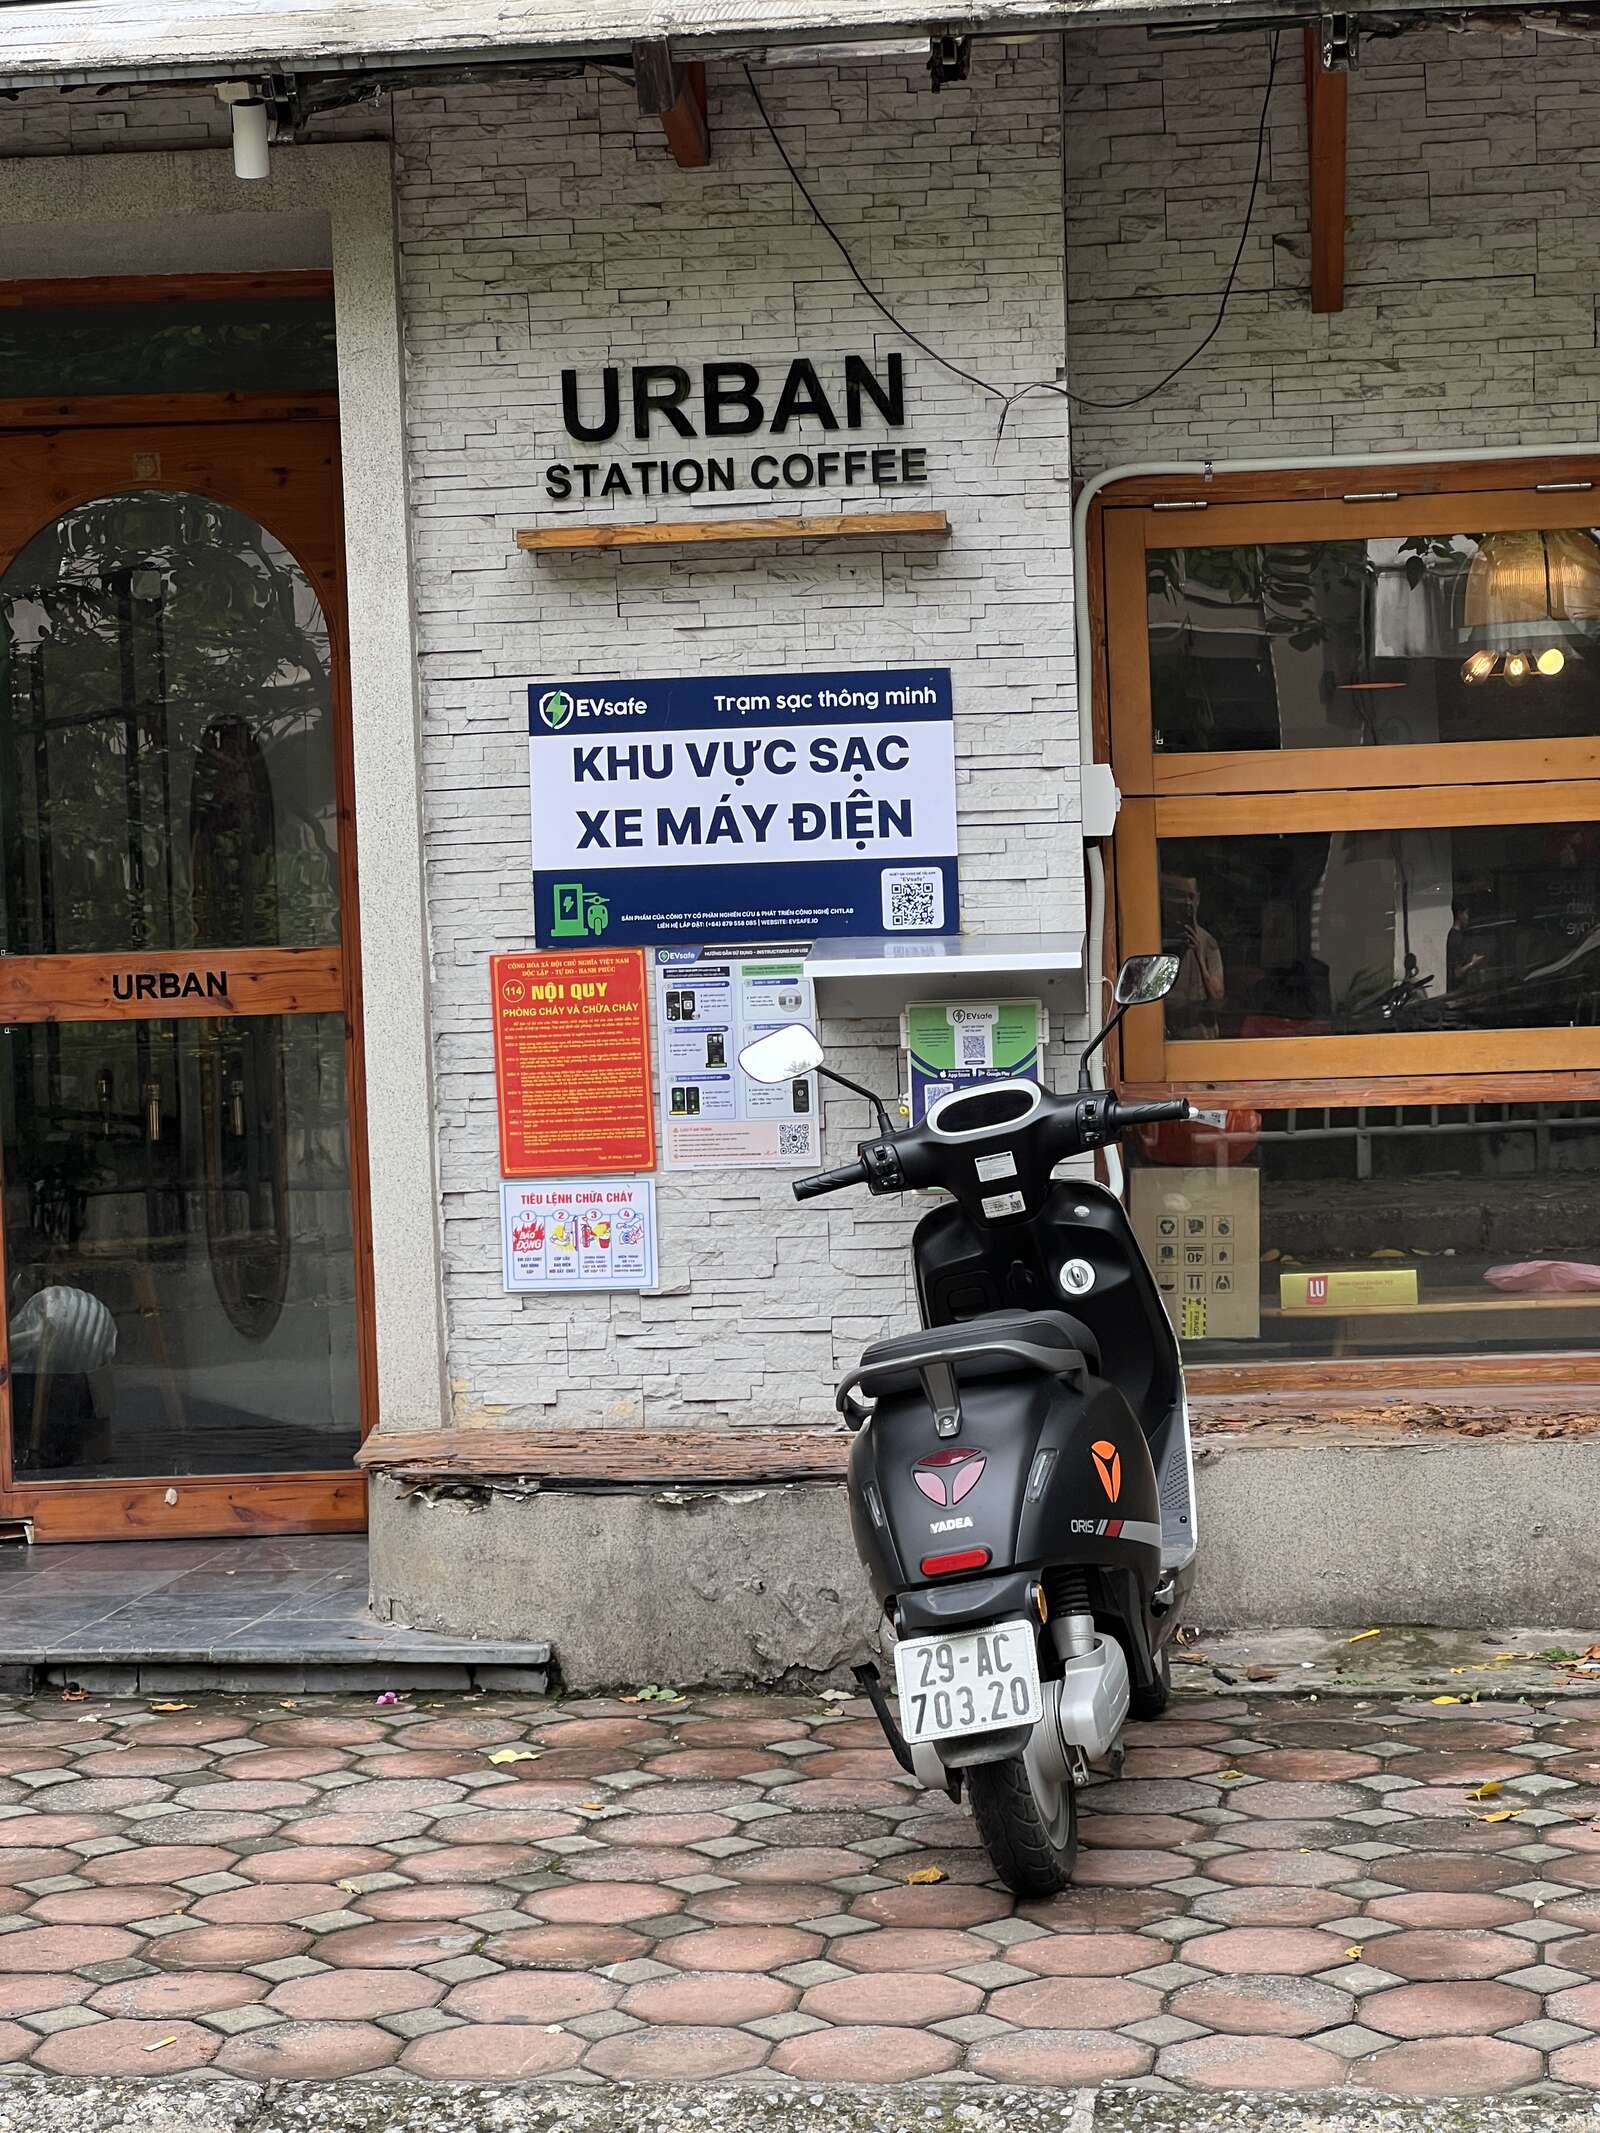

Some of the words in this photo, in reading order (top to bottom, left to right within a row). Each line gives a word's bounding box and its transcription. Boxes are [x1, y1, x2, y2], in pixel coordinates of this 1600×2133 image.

[561, 353, 904, 442] URBAN
[545, 457, 735, 499] STATION
[750, 448, 928, 490] COFFEE
[576, 697, 648, 717] EVsafe
[713, 695, 771, 715] Trạm
[776, 693, 813, 712] sạc
[817, 689, 879, 710] thông
[885, 686, 937, 705] minh
[573, 743, 673, 783] KHU
[685, 738, 797, 787] VỰC
[809, 735, 910, 783] SẠC
[576, 808, 643, 849] XE
[656, 793, 779, 847] MÁY
[787, 788, 913, 851] ĐIỆN
[669, 952, 695, 960] EVsafe
[112, 971, 228, 1000] URBAN
[505, 986, 522, 996] 114
[531, 981, 564, 1003] NỘI
[570, 982, 608, 1000] QUY
[503, 1005, 536, 1017] PHÒNG
[538, 1004, 565, 1016] CHÁY
[566, 1003, 580, 1014] VÀ
[581, 1002, 610, 1014] CHỮA
[611, 1000, 639, 1012] CHÁY
[966, 1012, 993, 1020] EVsafe
[521, 1192, 543, 1205] TIÊU
[546, 1191, 572, 1207] LỆNH
[575, 1190, 603, 1204] CHỮA
[606, 1190, 633, 1203] CHÁY
[525, 1212, 531, 1220] 1
[558, 1211, 564, 1220] 2
[591, 1210, 598, 1219] 3
[623, 1209, 630, 1218] 4
[1309, 1280, 1325, 1298] LU
[930, 1516, 974, 1534] YADEA
[1070, 1519, 1095, 1533] ORIS
[917, 1633, 1013, 1688] 29-AC
[911, 1676, 1030, 1735] 703.20
